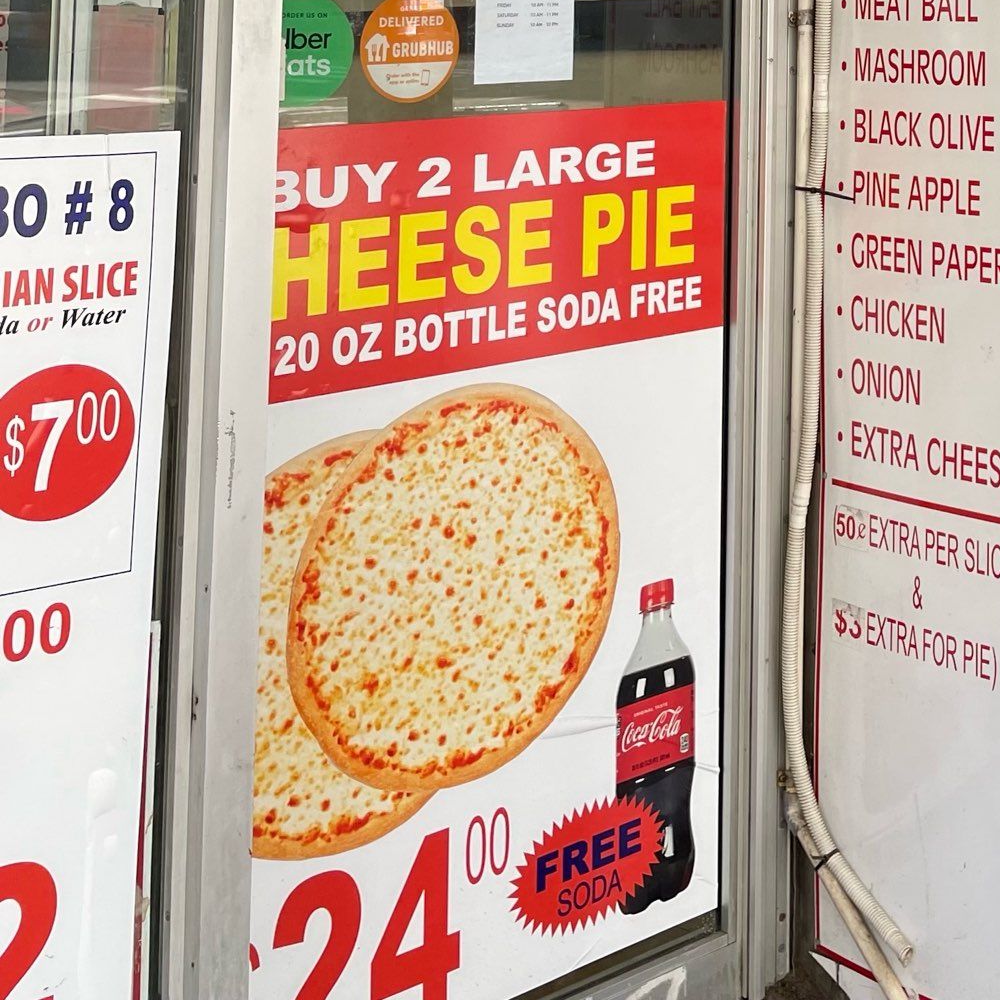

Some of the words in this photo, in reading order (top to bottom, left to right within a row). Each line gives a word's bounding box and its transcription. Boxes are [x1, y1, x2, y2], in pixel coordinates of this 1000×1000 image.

[379, 16, 444, 28] DELIVERED
[286, 55, 331, 76] ats
[392, 41, 454, 58] GRUBHUB
[854, 47, 986, 87] MASHROOM
[854, 108, 922, 147] BLACK
[929, 112, 995, 152] OLIVE
[274, 160, 397, 212] BUY
[417, 157, 452, 198] 2
[473, 139, 656, 193] LARGE
[853, 170, 900, 209] PINE
[908, 175, 981, 217] APPLE
[65, 180, 93, 236] #
[108, 178, 135, 233] 8
[581, 184, 696, 279] PIE
[851, 232, 922, 276] GREEN
[62, 260, 138, 303] SLICE
[27, 313, 53, 333] or
[62, 306, 126, 331] Water
[273, 332, 320, 377] 20
[332, 322, 384, 366] OZ
[394, 301, 527, 358] BOTTLE
[537, 287, 621, 333] SODA
[630, 275, 702, 319] FREE
[850, 295, 945, 344] CHICKEN
[851, 358, 921, 406] ONION
[851, 420, 919, 472] EXTRA
[868, 514, 921, 561] EXTRA
[925, 529, 959, 570] PER
[912, 575, 923, 610] &
[866, 611, 919, 661] EXTRA
[922, 628, 957, 672] FOR
[963, 639, 998, 692] PIE)
[535, 818, 643, 893] FREE
[557, 868, 624, 918] SODA
